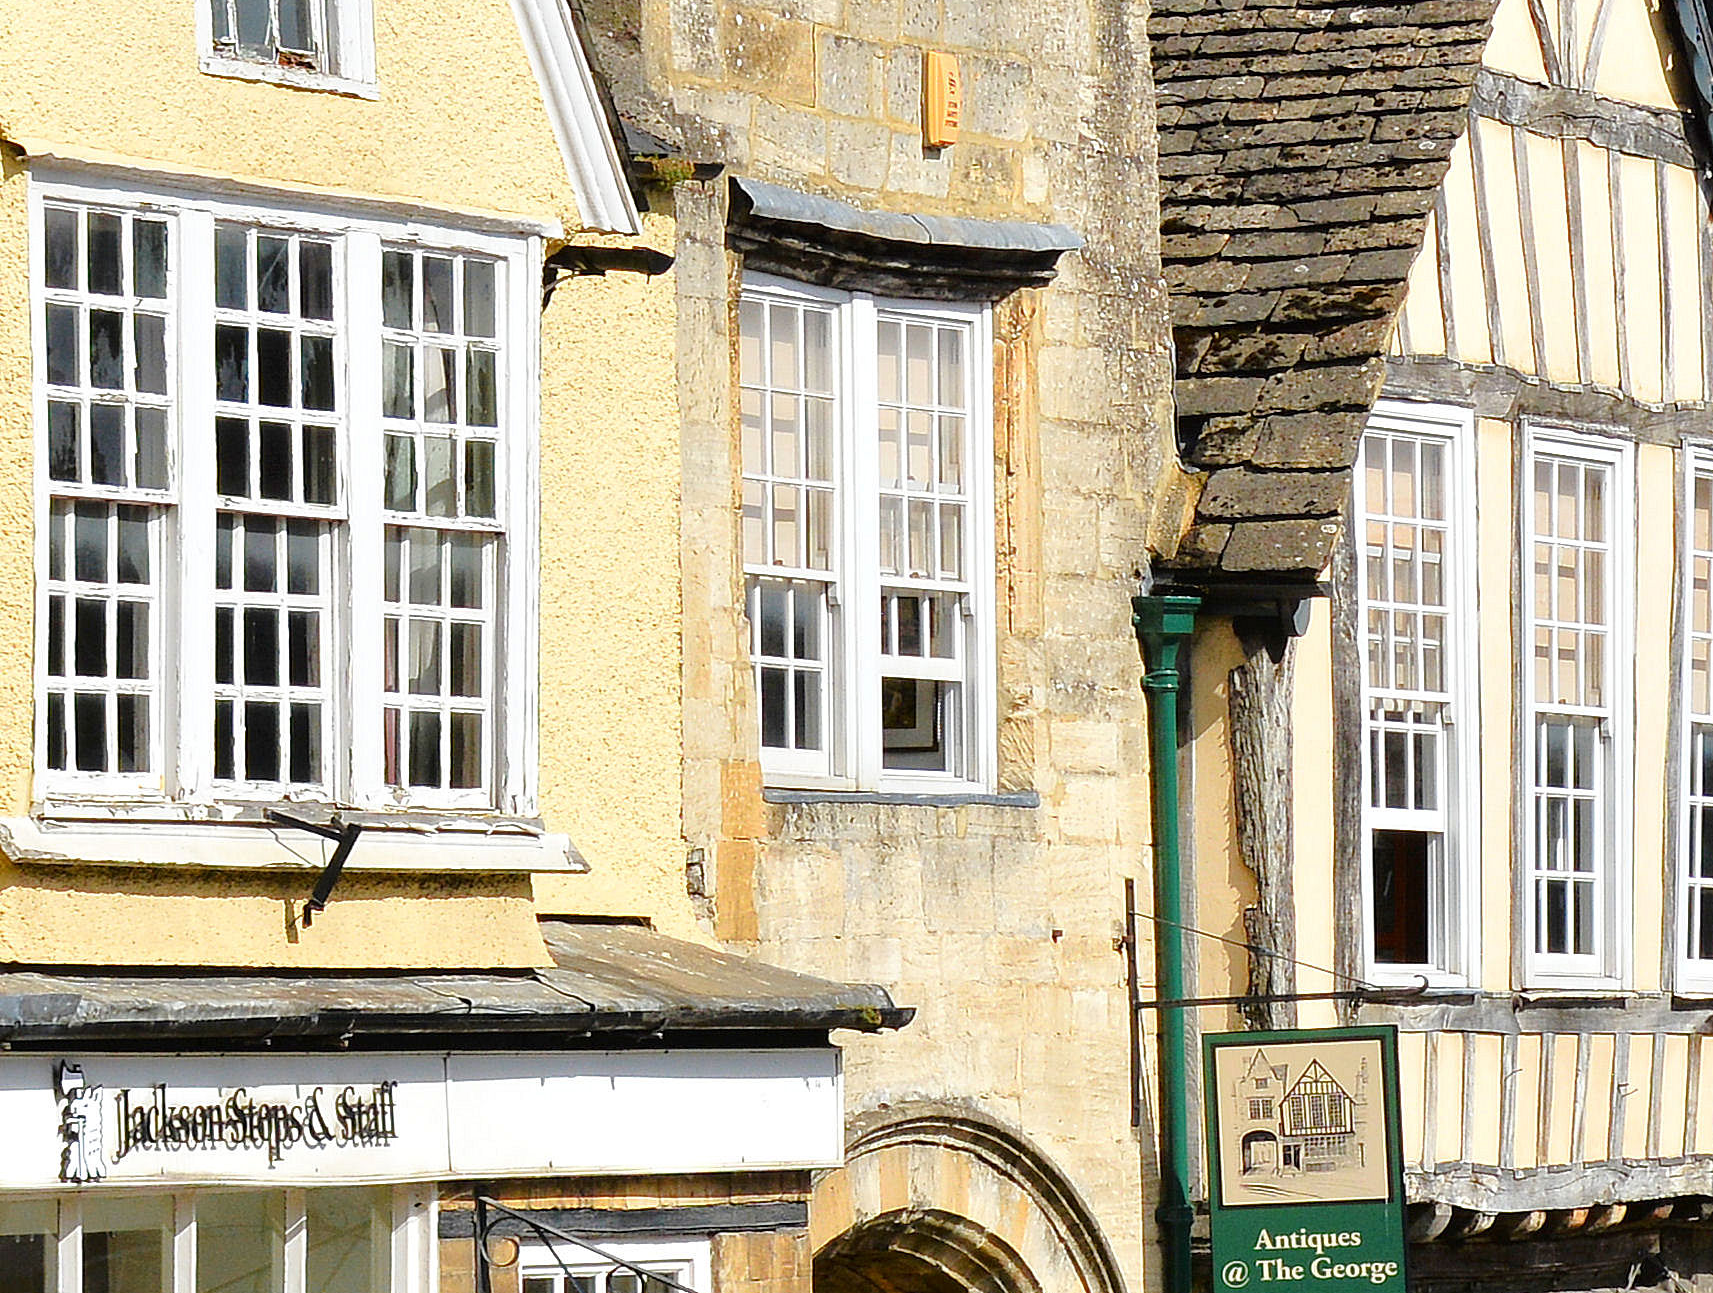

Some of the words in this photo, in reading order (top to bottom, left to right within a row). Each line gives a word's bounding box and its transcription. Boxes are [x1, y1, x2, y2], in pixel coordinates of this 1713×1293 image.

[306, 1087, 335, 1142] &
[337, 1081, 399, 1140] Staff
[1254, 1228, 1361, 1255] Antiques
[1222, 1260, 1250, 1288] @
[1256, 1258, 1305, 1282] The
[1310, 1257, 1398, 1284] George
